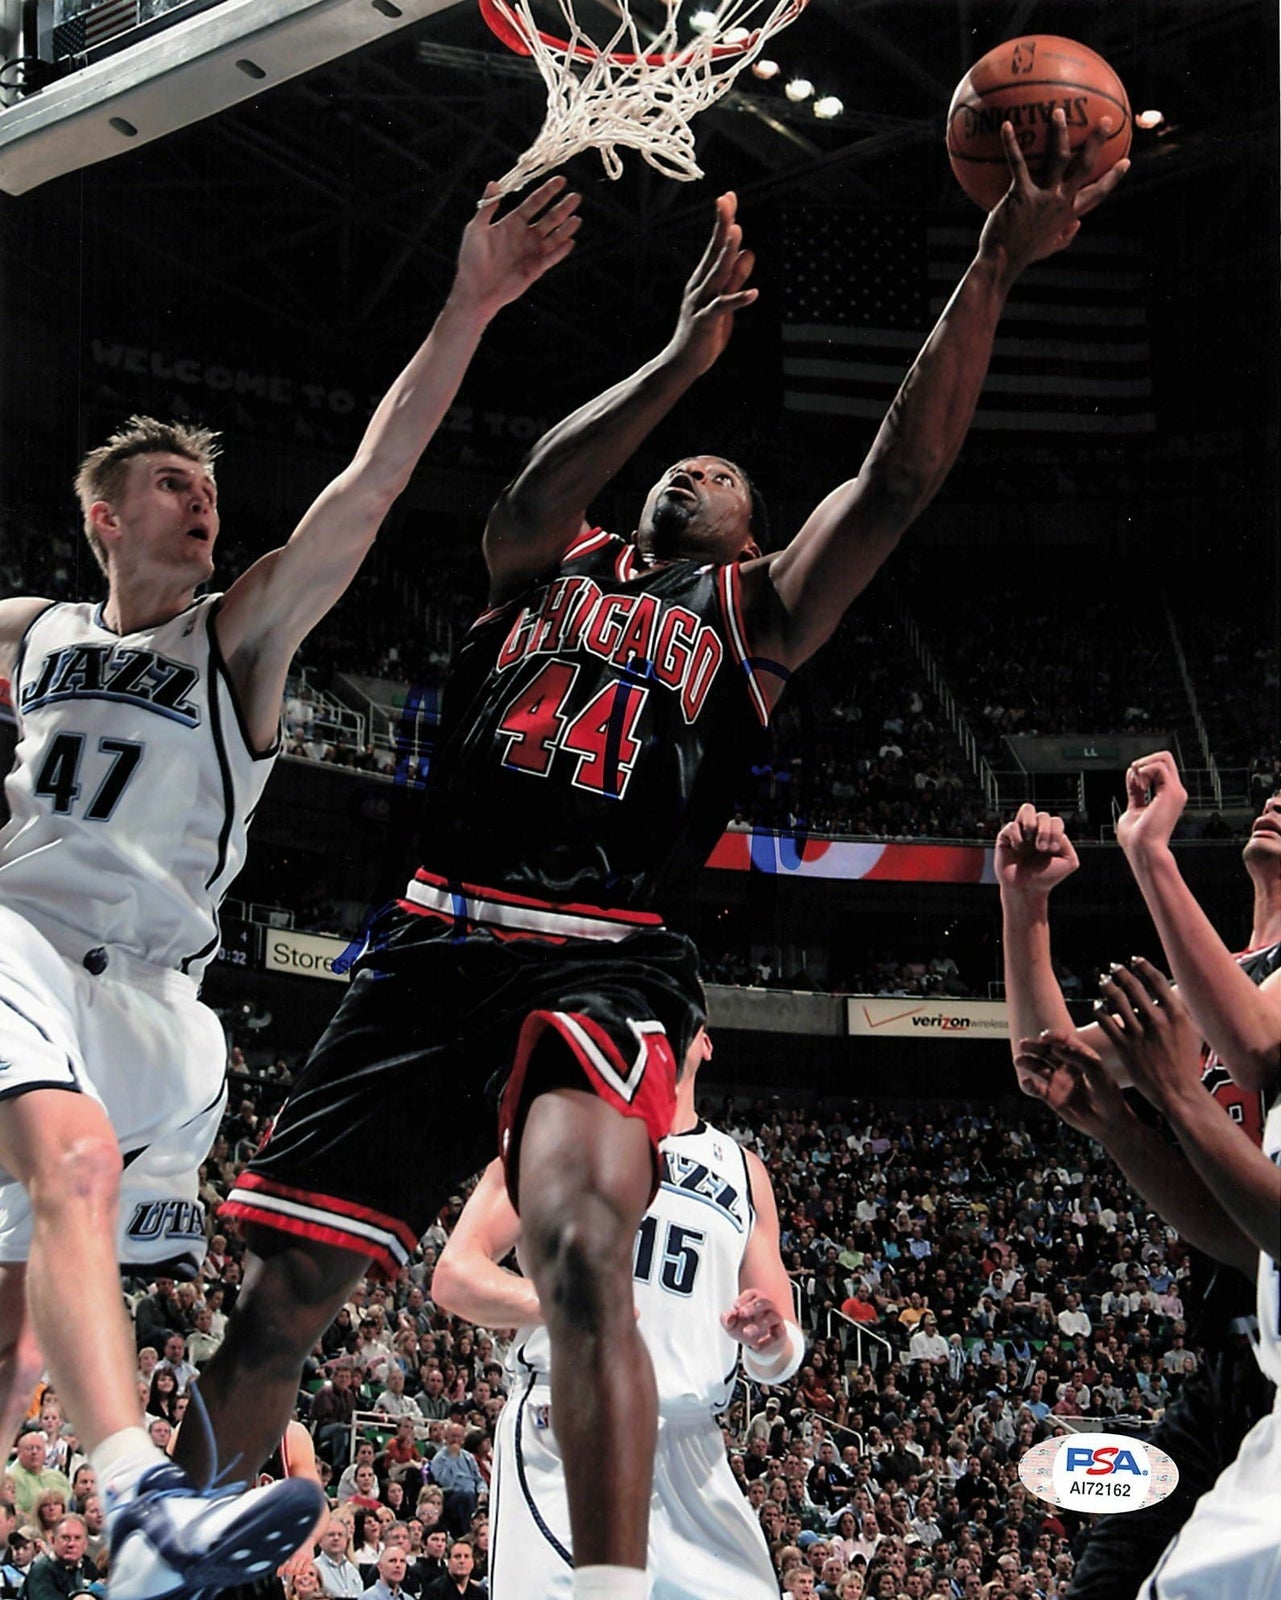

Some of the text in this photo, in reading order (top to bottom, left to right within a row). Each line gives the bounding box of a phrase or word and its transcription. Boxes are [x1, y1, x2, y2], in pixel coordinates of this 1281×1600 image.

[91, 338, 294, 404] WELCOME
[302, 383, 357, 414] TO
[21, 641, 202, 729] JAZZ
[495, 575, 723, 725] CHICAGO
[496, 657, 650, 801] 44
[34, 731, 147, 823] 47
[632, 1211, 707, 1298] 15
